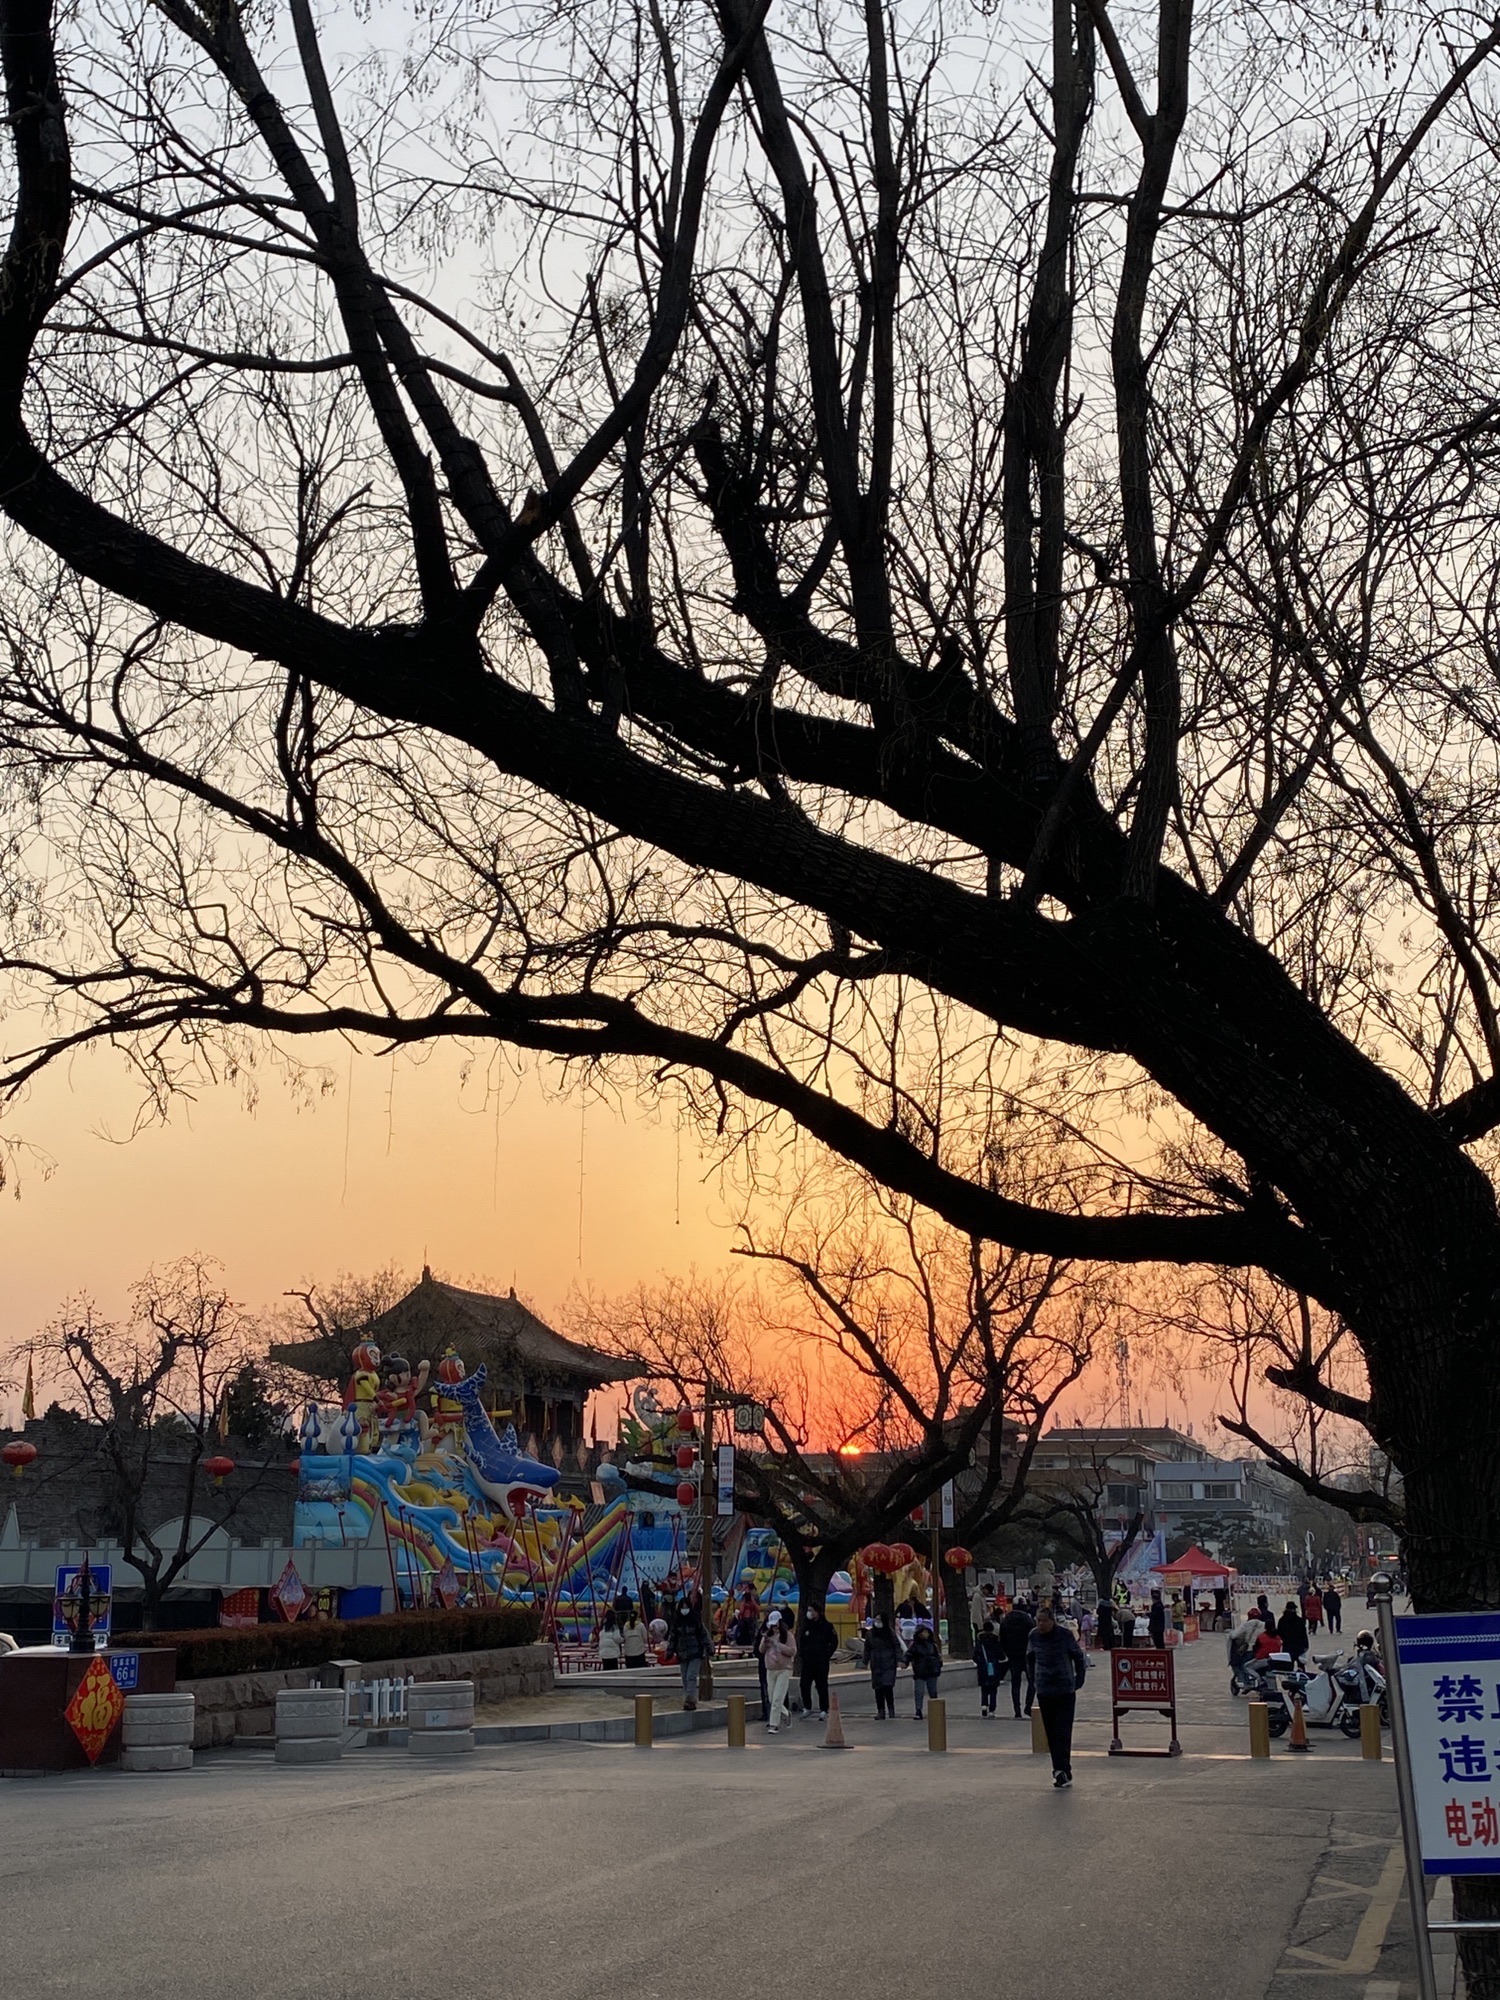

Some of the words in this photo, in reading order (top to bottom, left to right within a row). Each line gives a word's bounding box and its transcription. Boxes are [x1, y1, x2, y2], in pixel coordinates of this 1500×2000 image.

[116, 1666, 129, 1681] 66
[1134, 1682, 1167, 1691] 注意行人
[80, 1673, 113, 1731] 福
[1433, 1674, 1500, 1723] 禁
[1438, 1735, 1500, 1783] 违
